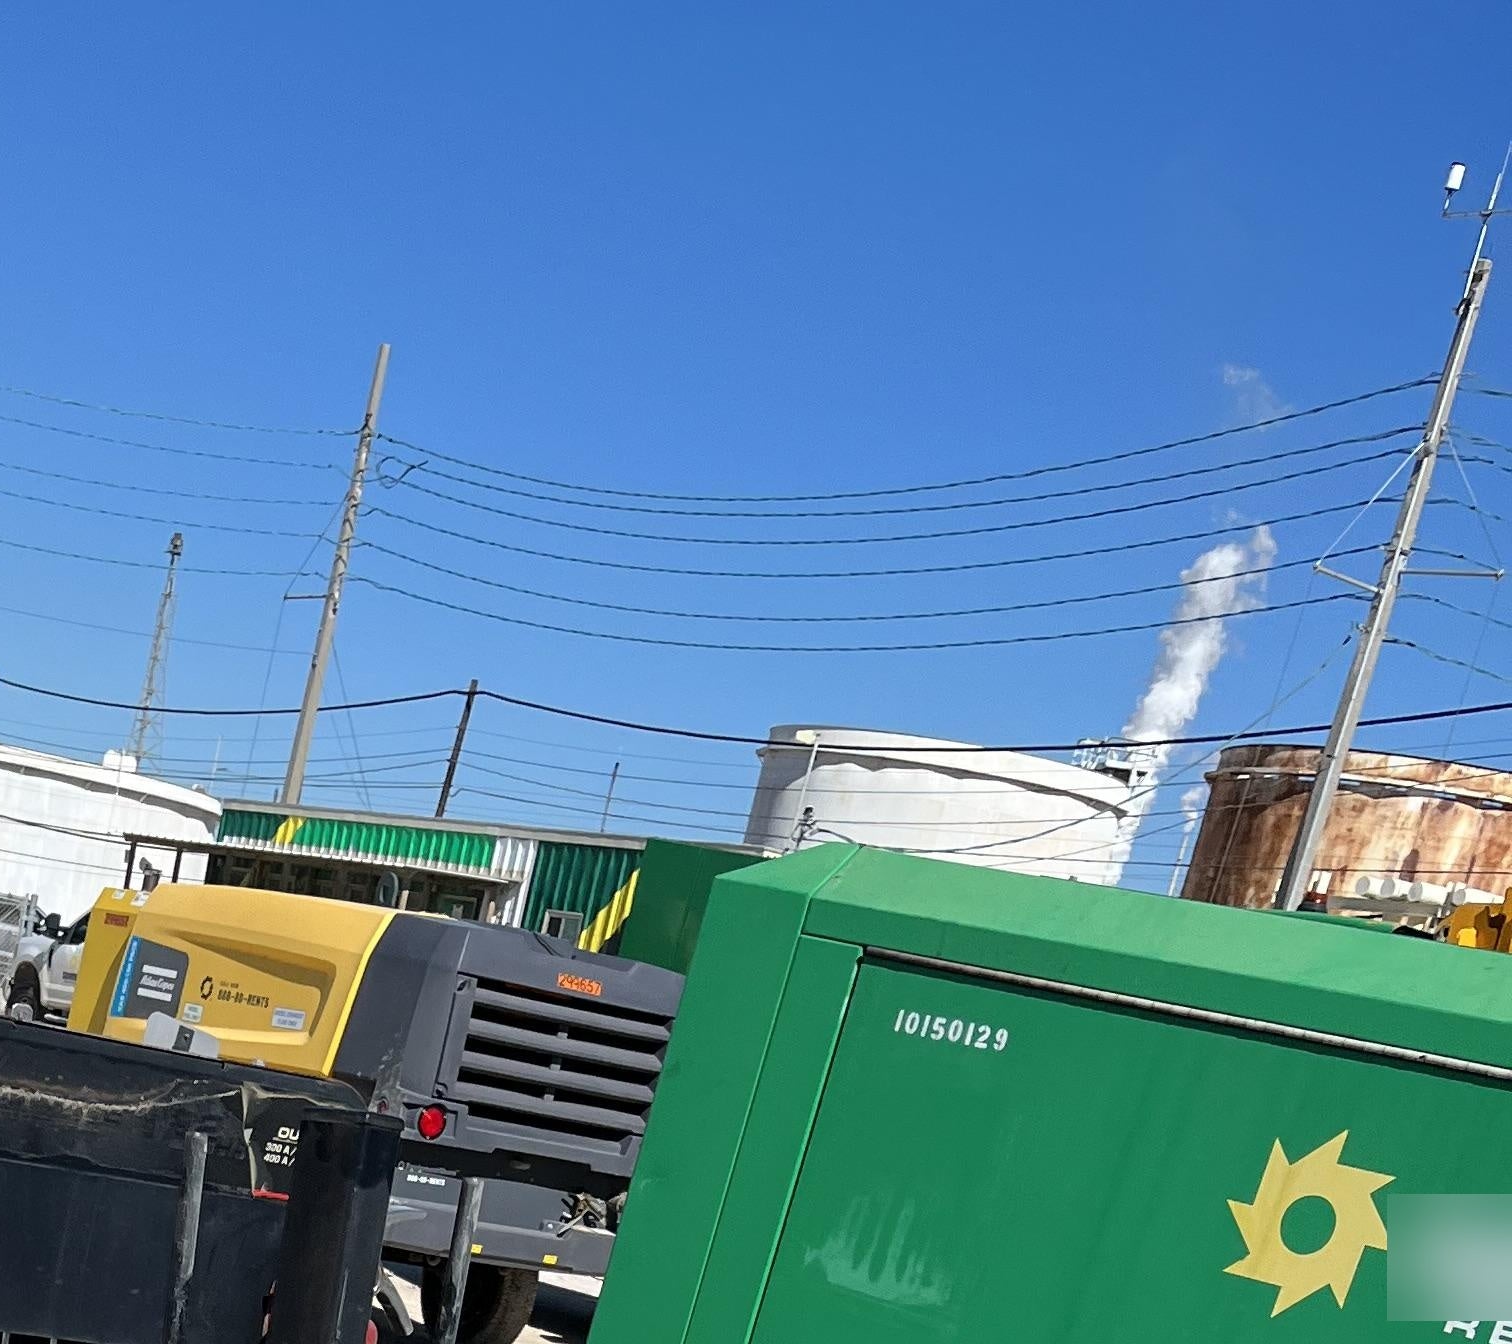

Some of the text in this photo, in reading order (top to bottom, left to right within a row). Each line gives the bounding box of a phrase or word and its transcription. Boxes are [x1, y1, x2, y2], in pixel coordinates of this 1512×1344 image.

[894, 1009, 1008, 1051] 10150129
[265, 1142, 282, 1152] 300
[283, 1145, 289, 1155] A
[264, 1153, 281, 1163] 400
[281, 1156, 288, 1165] A
